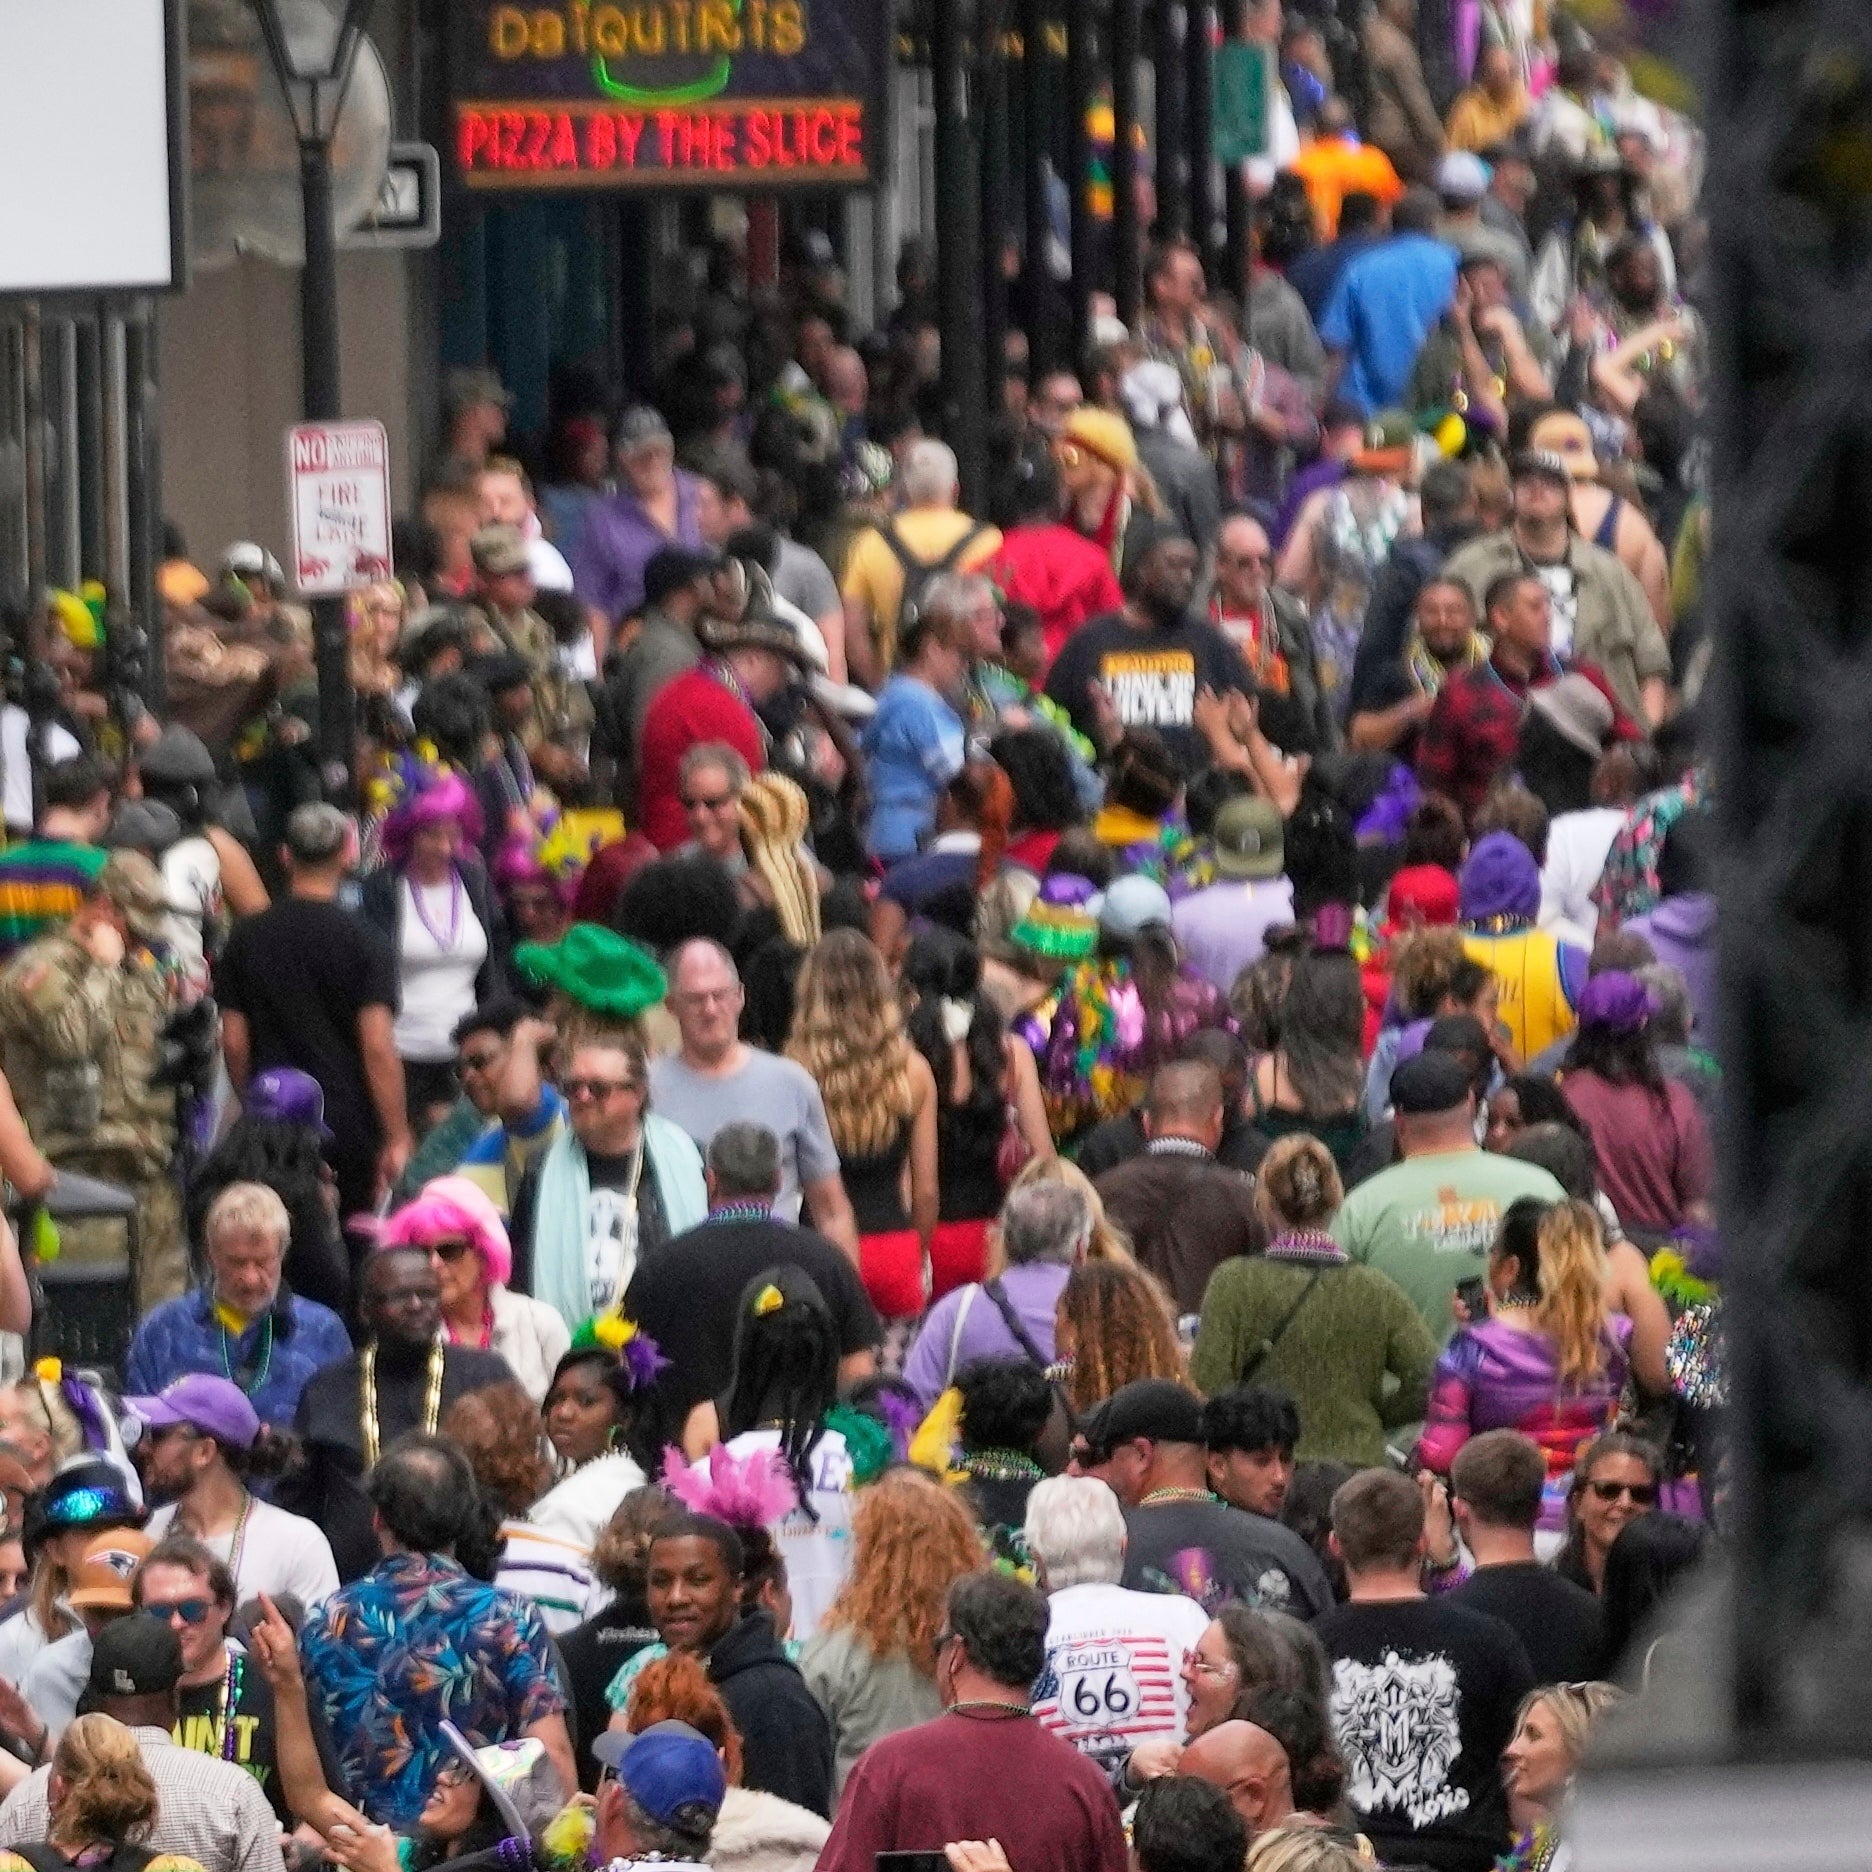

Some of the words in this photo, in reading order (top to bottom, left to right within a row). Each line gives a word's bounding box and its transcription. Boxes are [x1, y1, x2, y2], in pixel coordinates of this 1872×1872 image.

[462, 111, 579, 171] PIZZA
[589, 111, 644, 171] BY
[656, 110, 736, 172] THE
[747, 106, 863, 169] SLICE
[1067, 1651, 1121, 1668] ROUTE
[1073, 1671, 1132, 1718] 66
